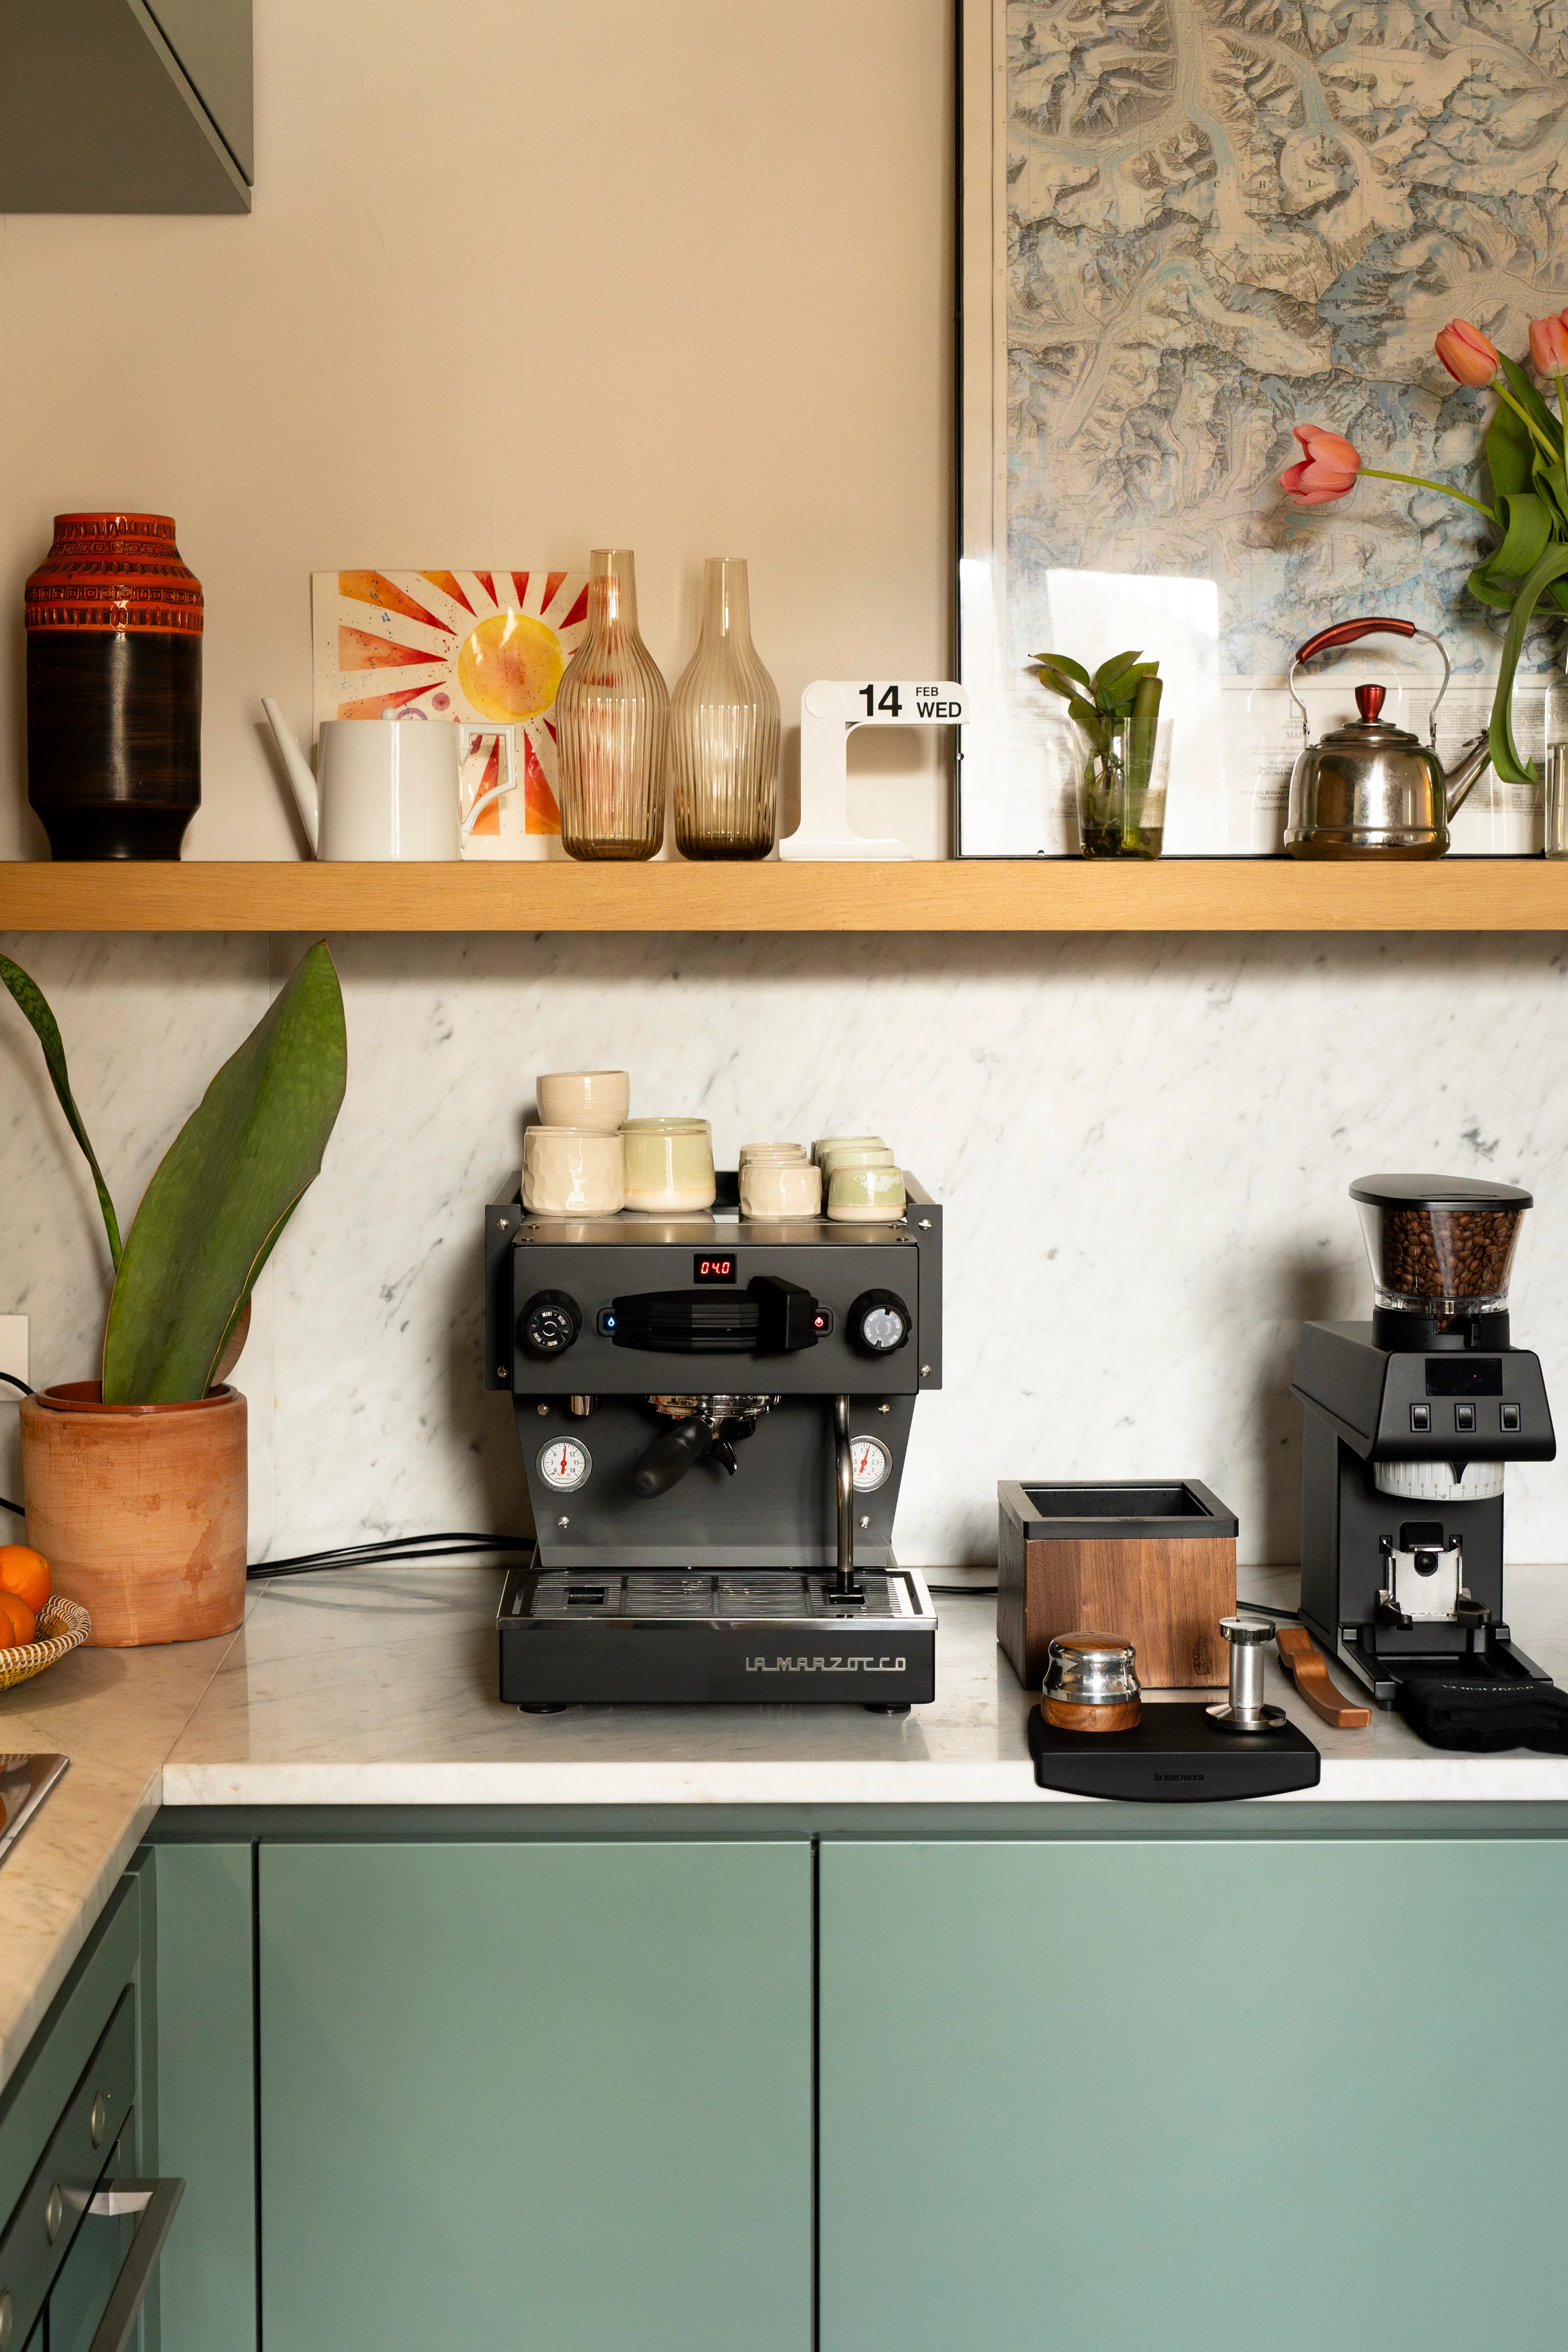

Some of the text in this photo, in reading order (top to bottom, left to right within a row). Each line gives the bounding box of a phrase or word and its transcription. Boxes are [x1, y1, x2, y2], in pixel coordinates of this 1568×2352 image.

[859, 684, 939, 717] 14 FEB
[917, 702, 962, 718] WED
[557, 1315, 567, 1325] MINI
[746, 1657, 765, 1671] LA
[1154, 1772, 1162, 1781] la
